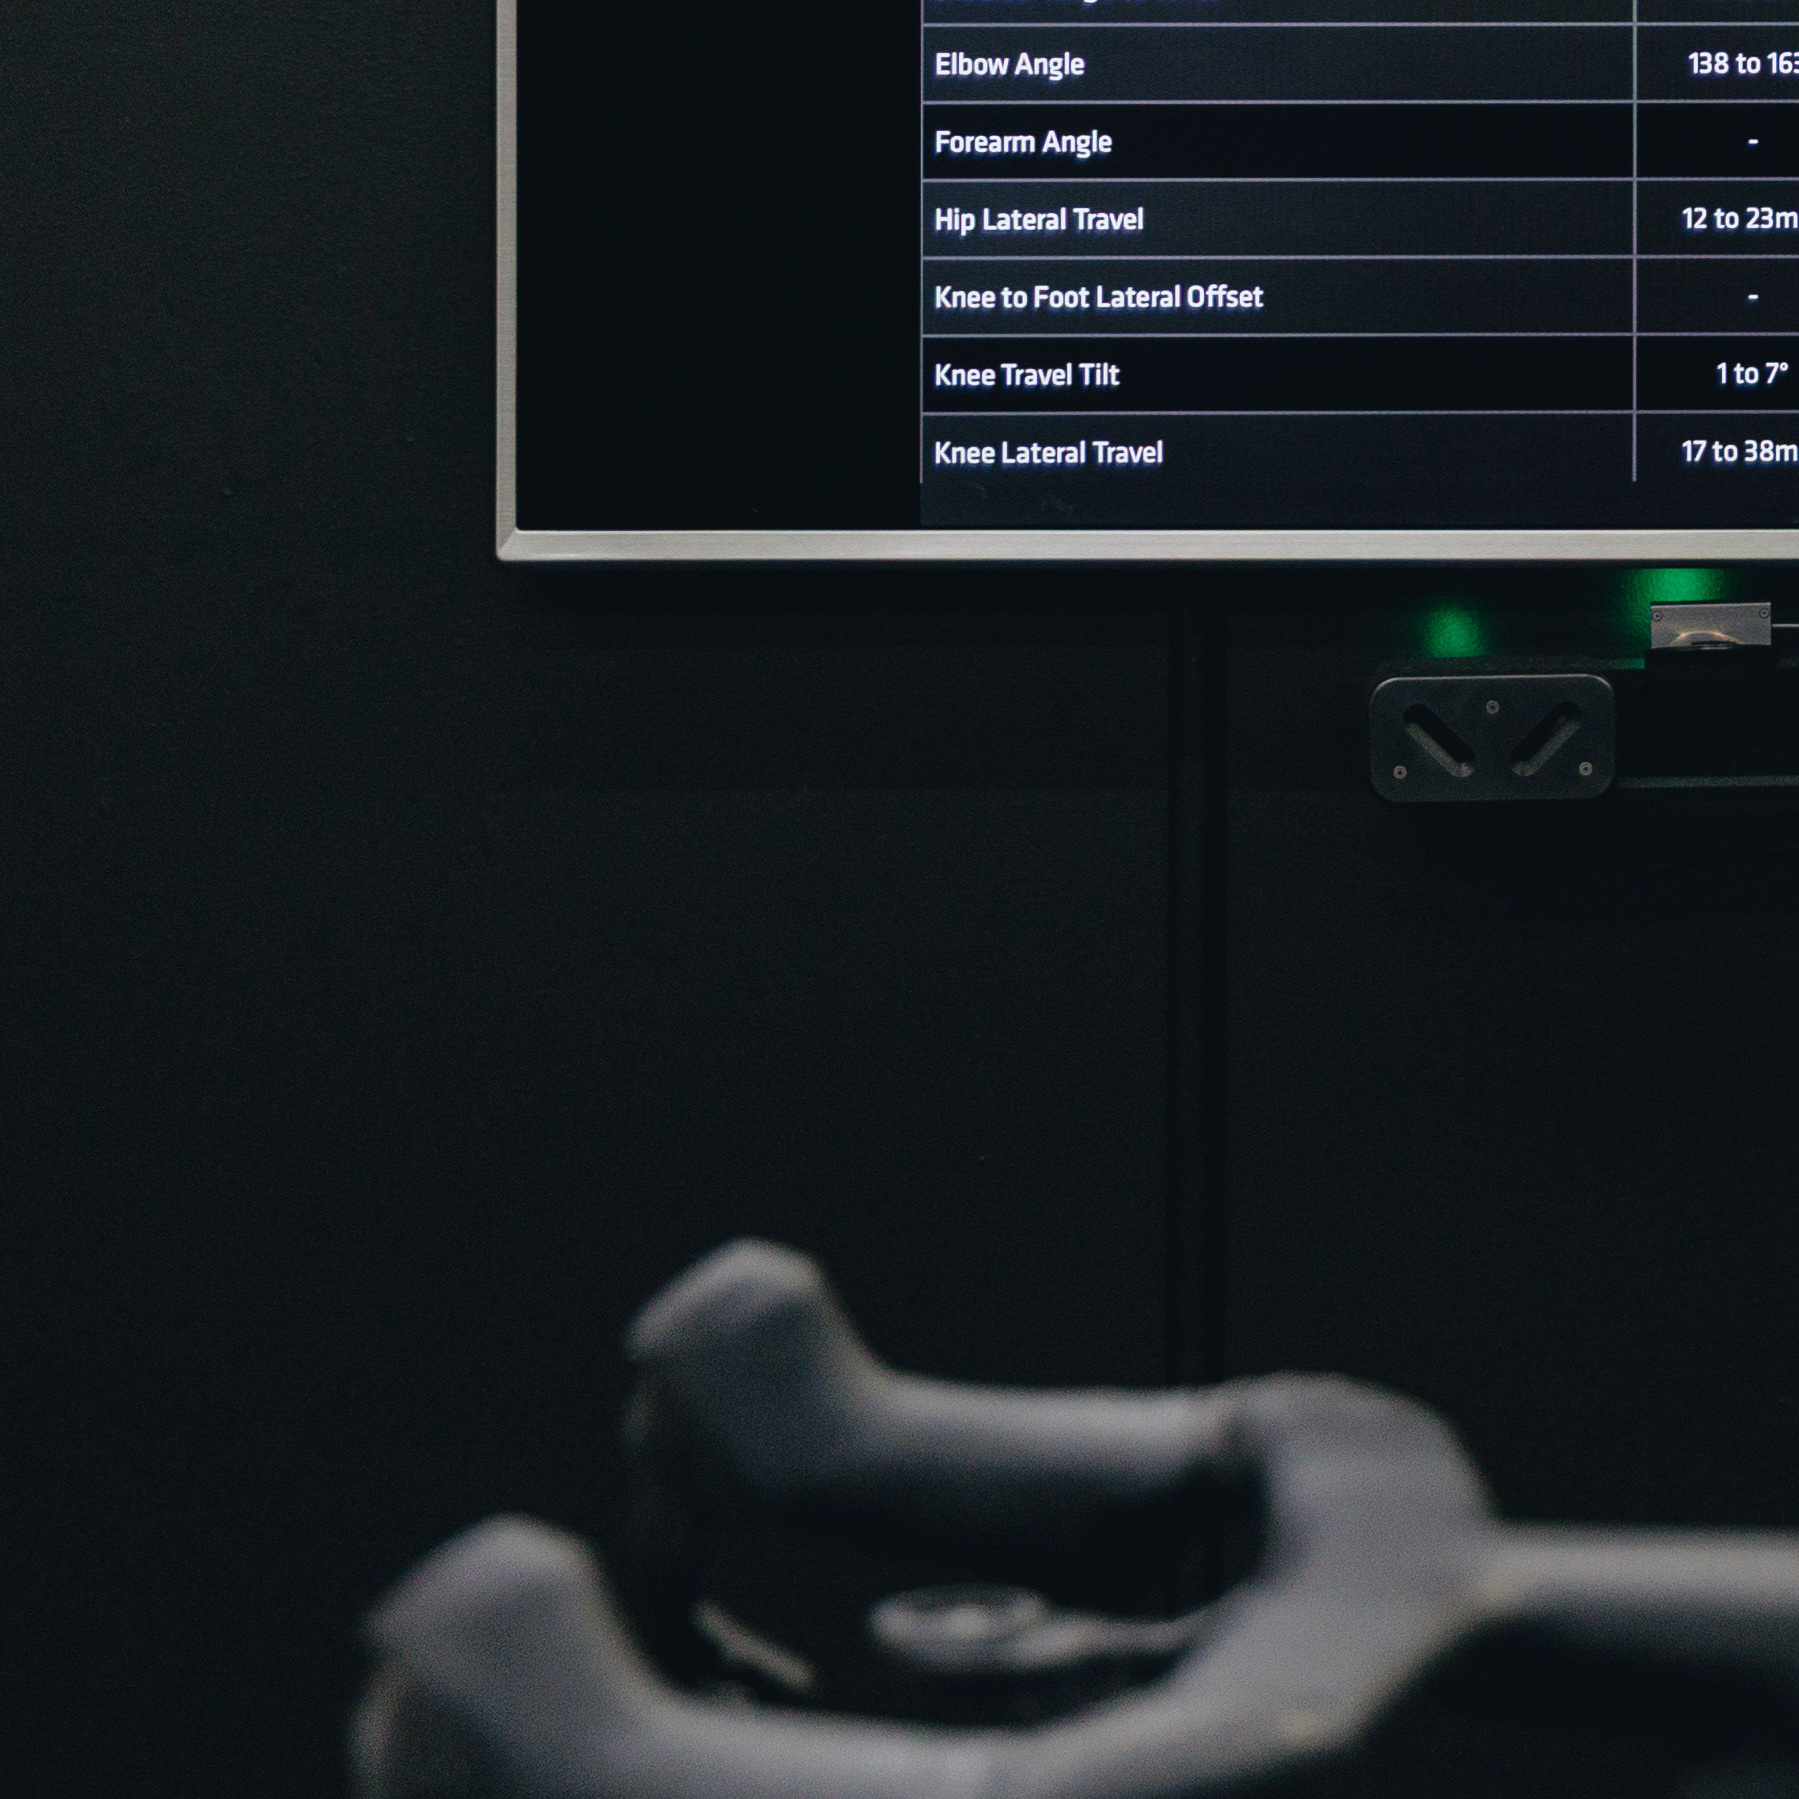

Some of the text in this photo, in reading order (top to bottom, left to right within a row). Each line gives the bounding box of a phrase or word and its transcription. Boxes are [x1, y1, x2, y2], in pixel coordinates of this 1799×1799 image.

[935, 283, 1265, 309] Knee to Foot Lateral Offset
